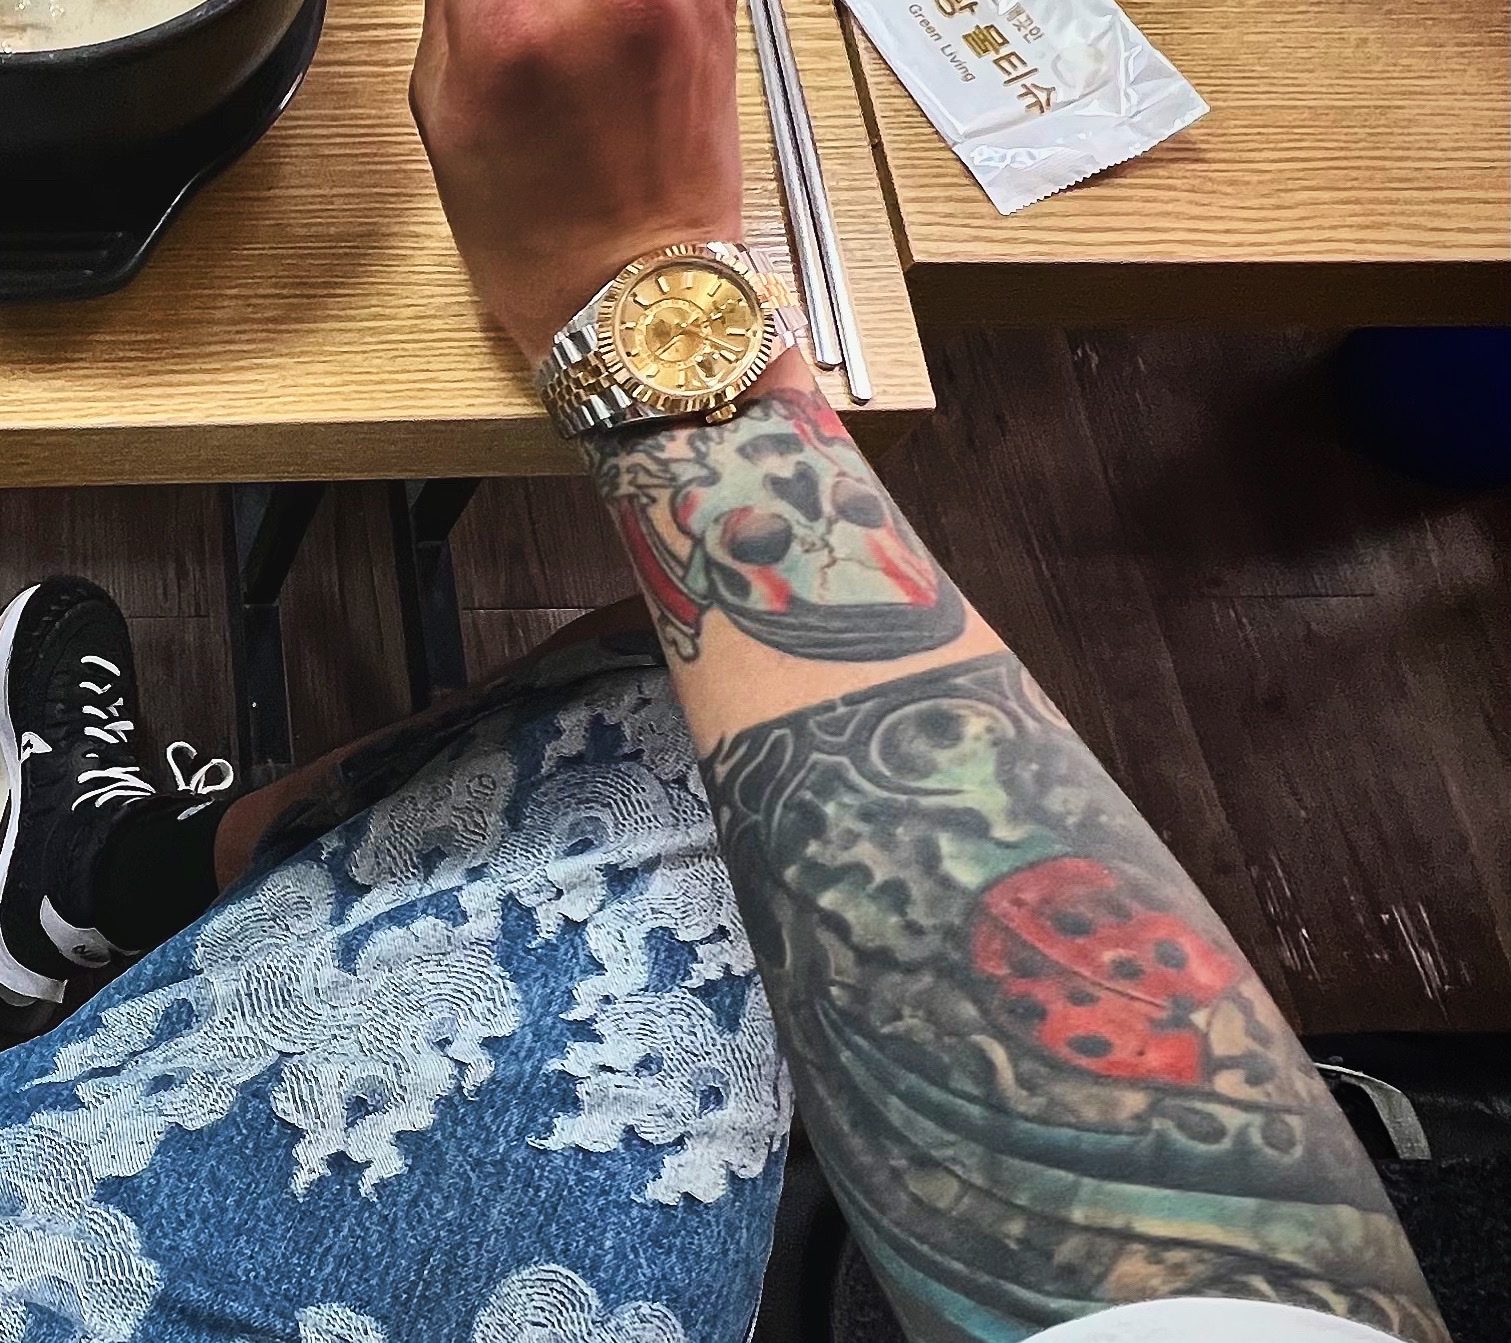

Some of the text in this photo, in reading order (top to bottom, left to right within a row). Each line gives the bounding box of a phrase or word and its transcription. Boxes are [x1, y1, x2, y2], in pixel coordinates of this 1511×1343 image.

[908, 3, 943, 42] Green
[940, 44, 976, 83] Living
[962, 23, 1059, 115] 물티슈
